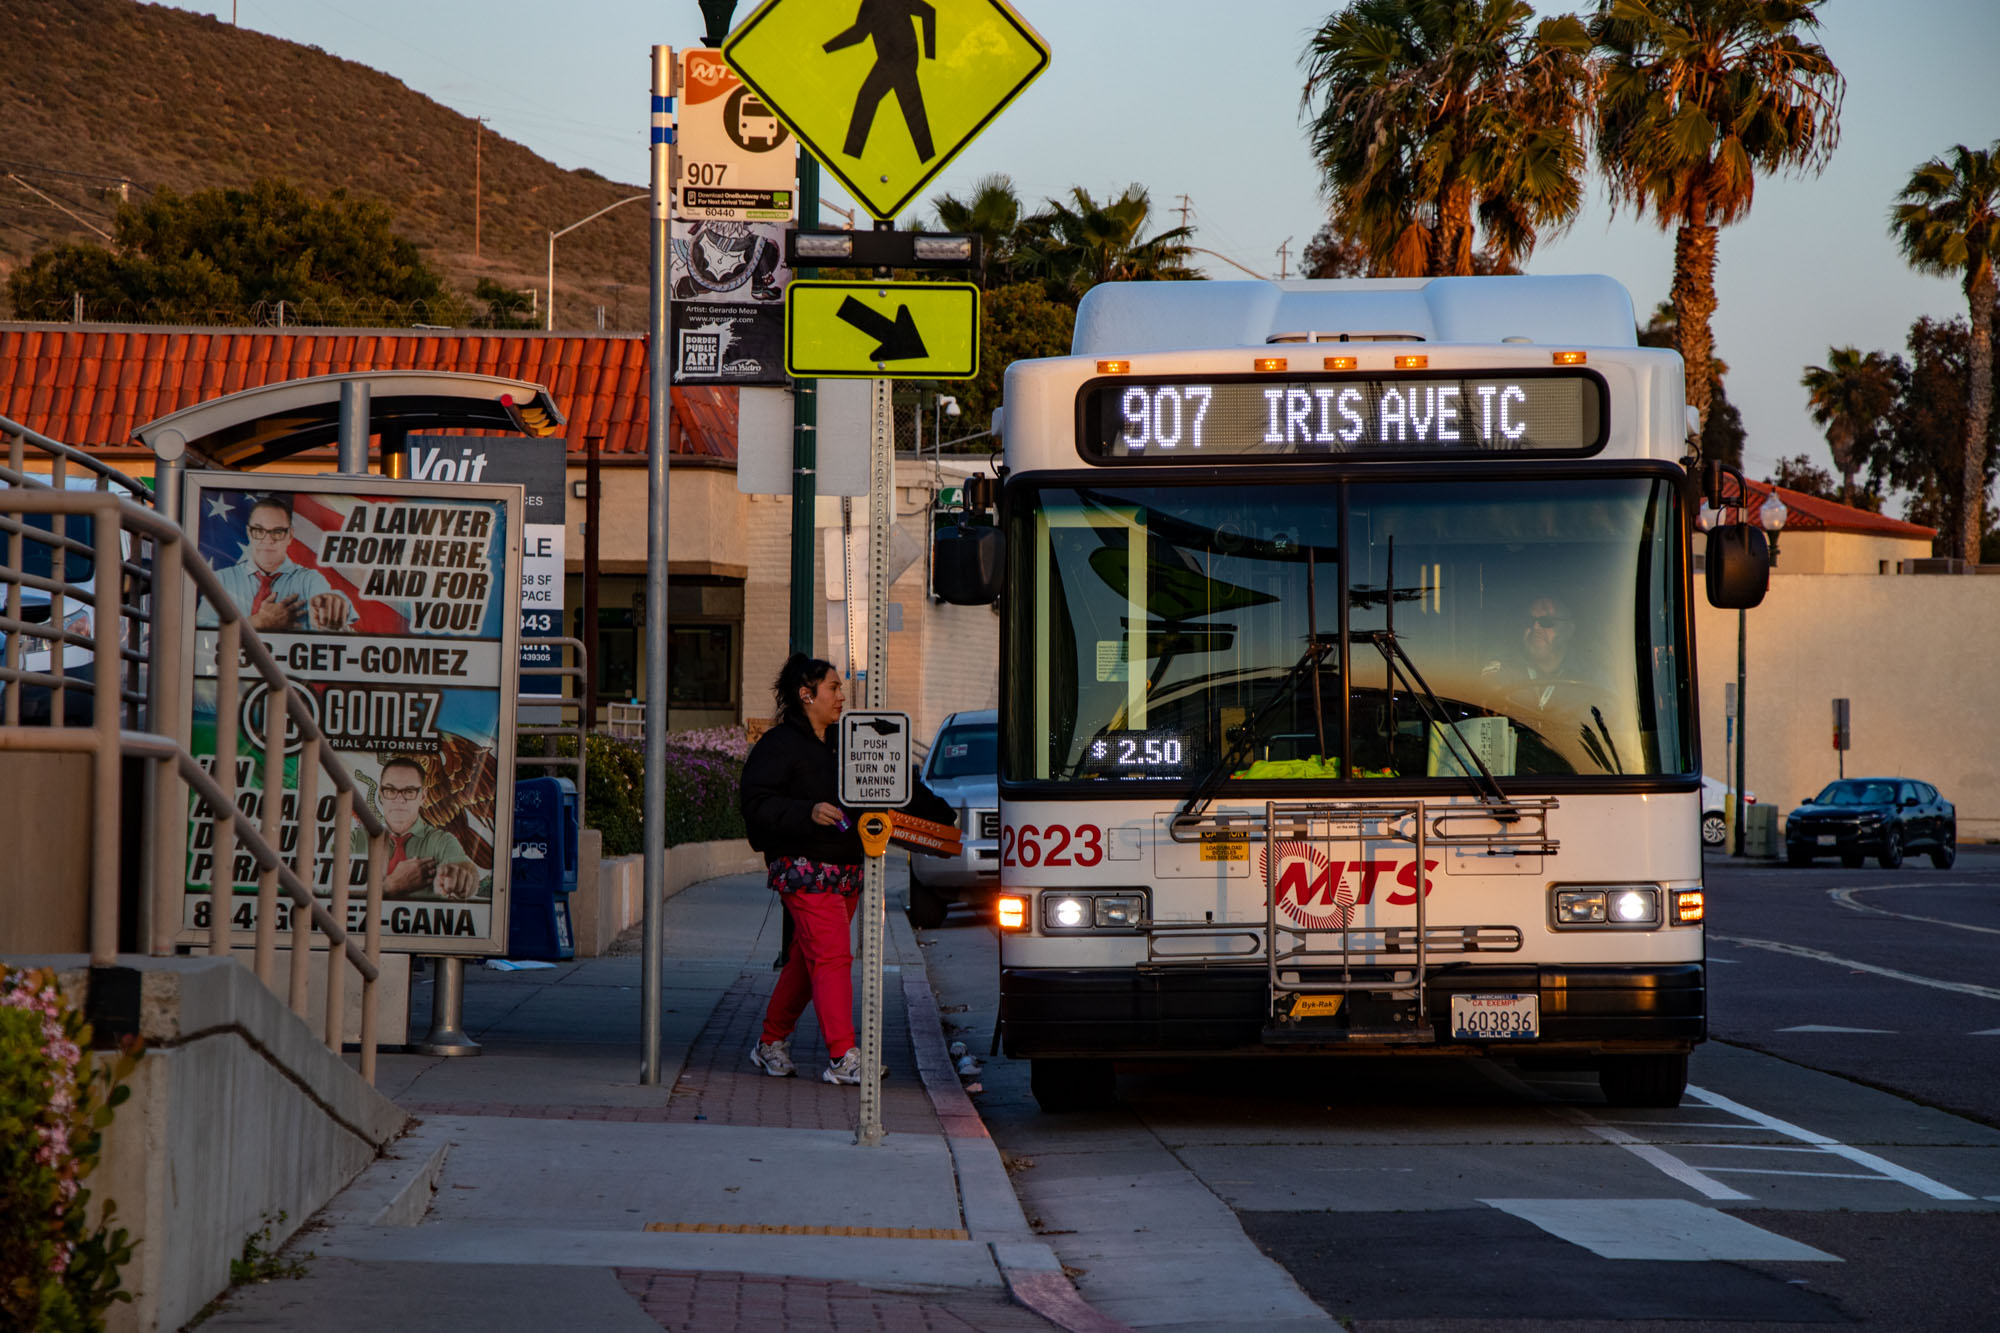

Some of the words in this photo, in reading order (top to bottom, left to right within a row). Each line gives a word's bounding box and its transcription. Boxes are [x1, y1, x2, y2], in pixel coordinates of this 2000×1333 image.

[687, 163, 728, 186] 907
[724, 192, 759, 200] OneBusAway
[705, 207, 735, 217] 60440
[685, 305, 708, 313] Artist:
[709, 306, 738, 314] Gerardo
[738, 307, 758, 315] Meza
[685, 336, 717, 344] BORDER
[685, 344, 717, 353] PUBLIC
[685, 352, 717, 366] ART
[722, 363, 738, 372] San
[738, 362, 762, 372] Ysidro
[1123, 386, 1212, 448] 907
[1264, 388, 1363, 443] IRIS
[1380, 386, 1460, 441] AVE
[1477, 384, 1526, 440] TC
[410, 447, 488, 482] Voit
[346, 506, 368, 533] A
[373, 506, 491, 538] LAWYER
[321, 535, 404, 565] FROM
[410, 539, 488, 573] HERE,
[364, 569, 428, 598] AND
[432, 571, 489, 600] FOR
[537, 575, 552, 585] SF
[413, 601, 483, 632] YOU!
[324, 688, 440, 739] GOMEZ
[365, 740, 439, 751] ATTORNEYS
[863, 739, 888, 749] PUSH
[850, 751, 884, 761] BUTTON
[889, 751, 901, 761] TO
[1092, 740, 1107, 759] $
[1119, 739, 1181, 764] 2.50
[854, 763, 878, 773] TURN
[883, 764, 896, 773] ON
[855, 776, 895, 785] WARNING
[860, 788, 891, 798] LIGHTS
[893, 829, 944, 848] HOT-N-READY
[1002, 823, 1103, 868] 2623
[1264, 859, 1440, 906] MTS
[1301, 1001, 1333, 1009] Byk-Rak
[1457, 1011, 1531, 1031] 1603836
